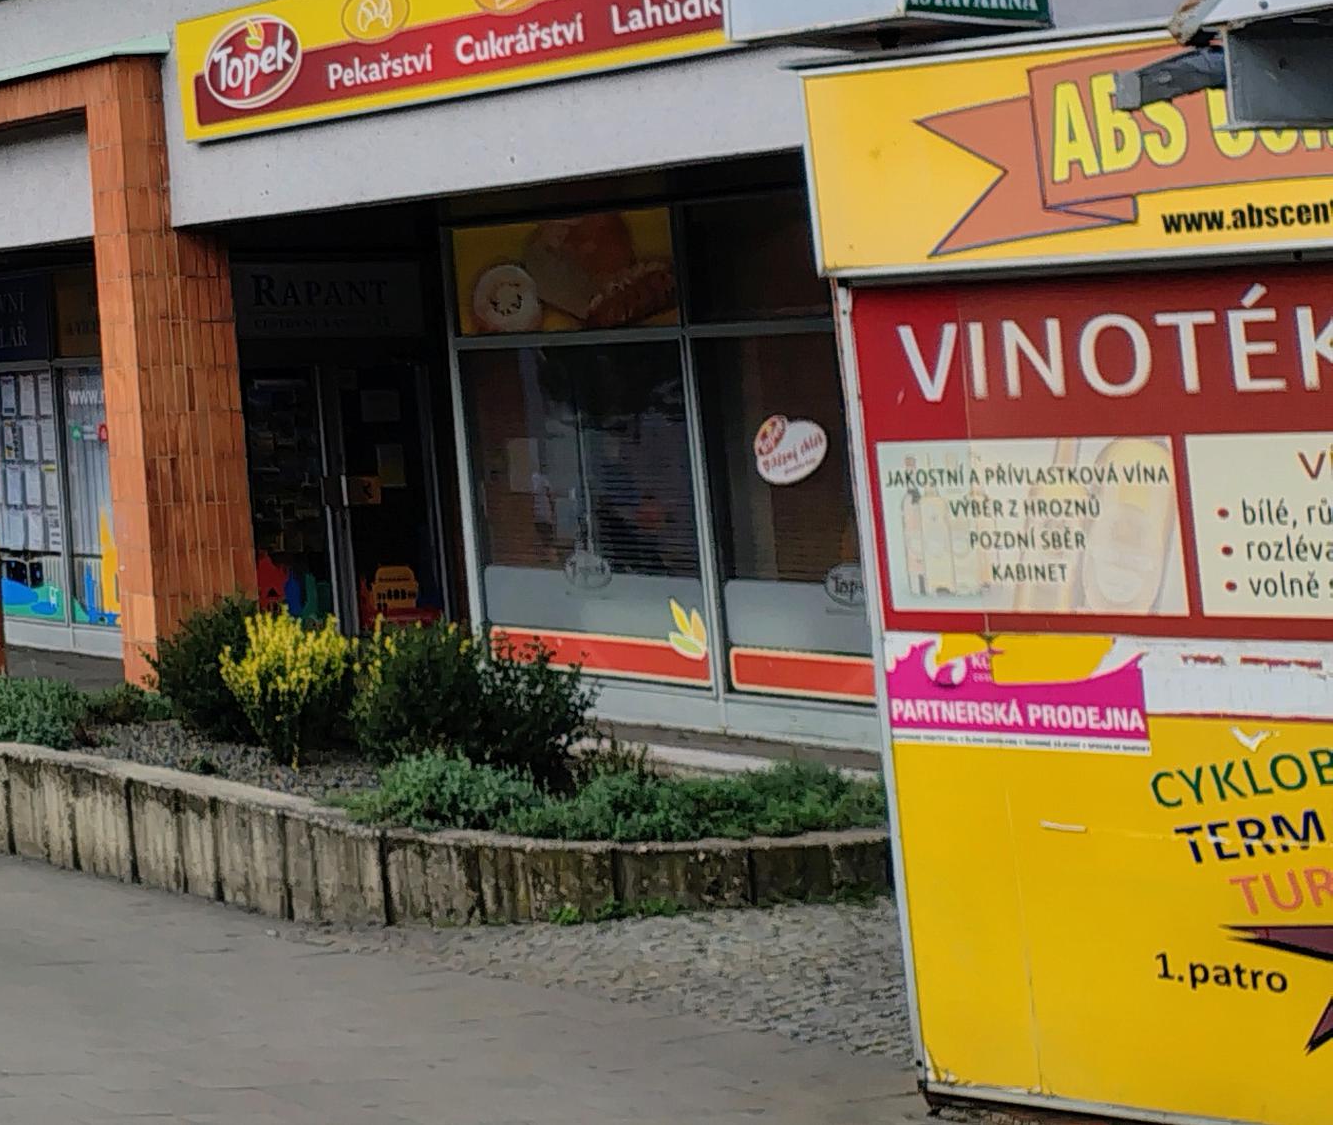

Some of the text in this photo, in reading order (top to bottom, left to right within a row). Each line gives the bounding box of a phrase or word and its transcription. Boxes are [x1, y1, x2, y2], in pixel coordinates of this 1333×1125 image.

[213, 27, 295, 97] Topek
[328, 45, 432, 90] Pekařství
[455, 12, 584, 65] Cukrářství
[252, 274, 388, 307] RAPANT
[898, 283, 1333, 403] VINOTÉK
[885, 459, 1170, 488] JAKOSTNÍ A PŘÍVLASTKOVÁ VÍNA
[949, 492, 1101, 519] VÝBĚR Z HROZNŮ
[1241, 497, 1298, 529] bílé,
[969, 527, 1086, 550] POZDNÍ SBĚR
[991, 562, 1068, 583] KABINET
[1249, 570, 1320, 599] volně
[891, 698, 1145, 732] PARTNERSKÁ PRODEJNA
[1155, 951, 1288, 993] 1.patro
